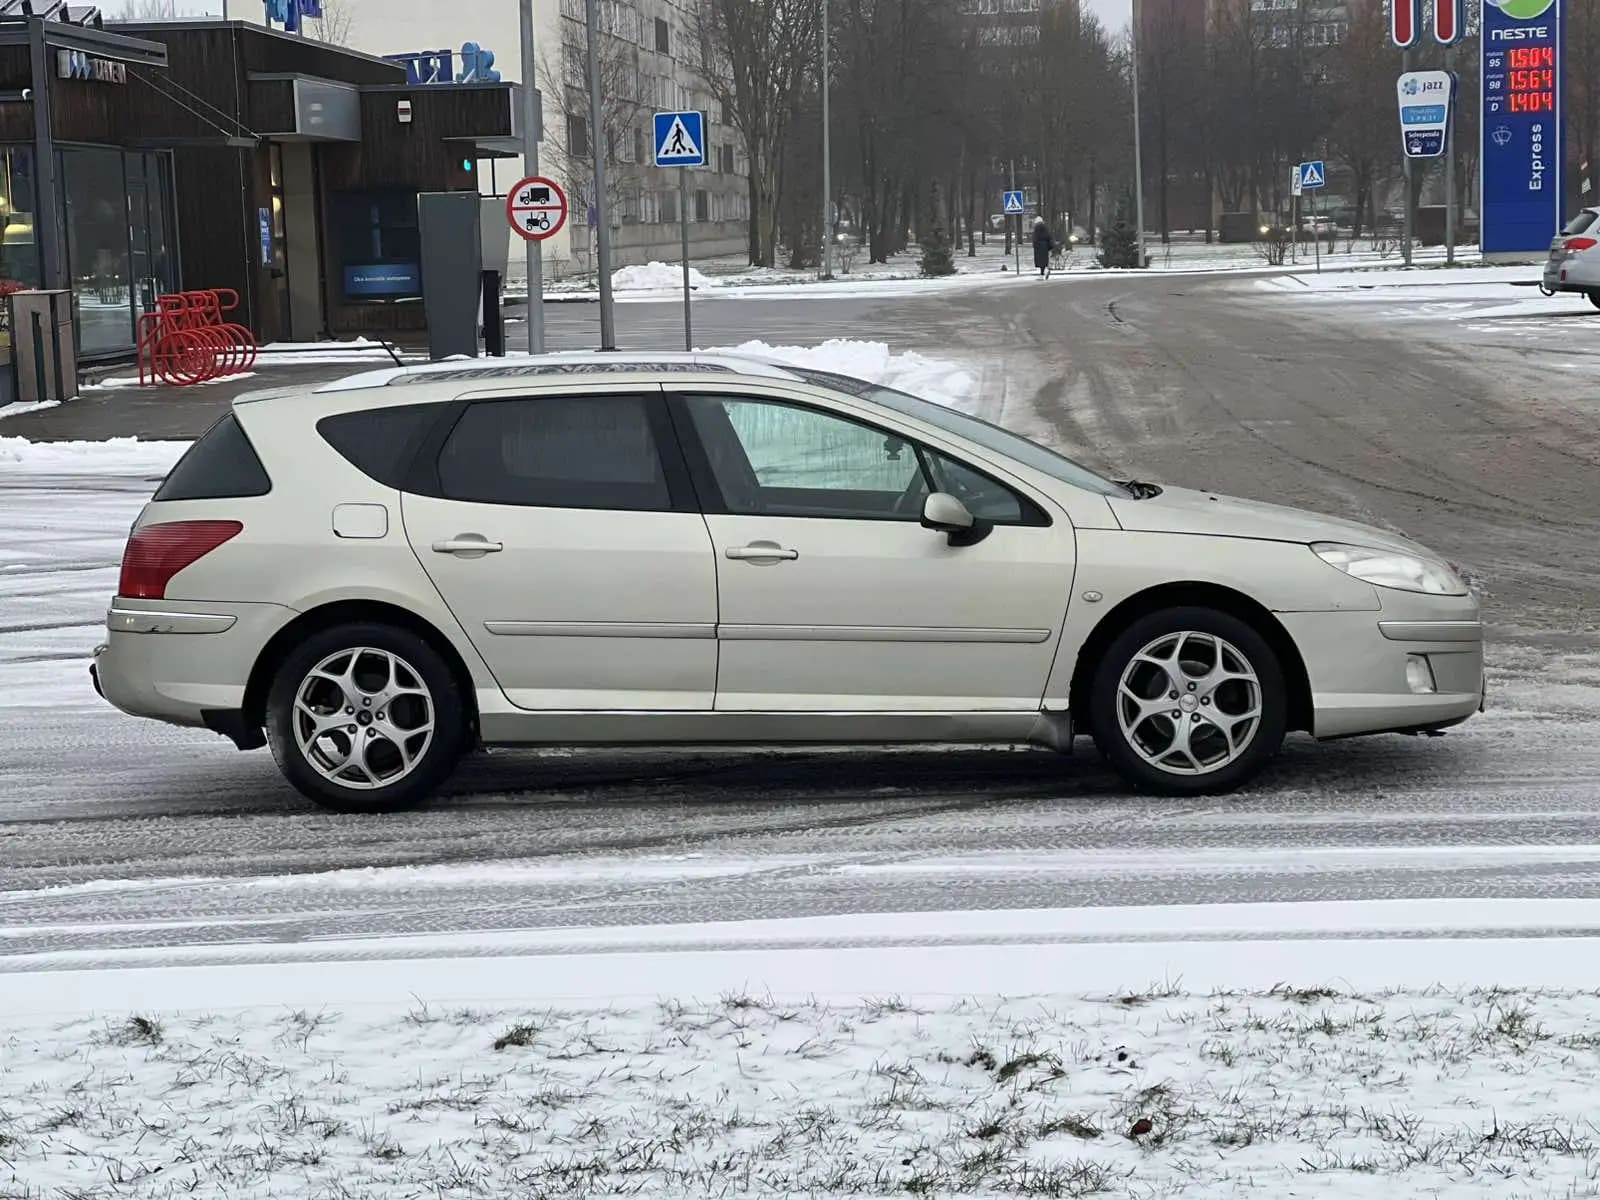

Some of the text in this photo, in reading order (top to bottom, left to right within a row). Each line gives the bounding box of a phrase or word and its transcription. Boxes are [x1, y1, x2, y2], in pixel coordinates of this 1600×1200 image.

[1491, 26, 1548, 40] NESTE
[1488, 47, 1553, 68] 95 1.504
[1422, 80, 1443, 92] jazz
[1488, 70, 1553, 89] 98 1.564
[1491, 92, 1553, 112] D 1.404
[1529, 123, 1545, 190] Express
